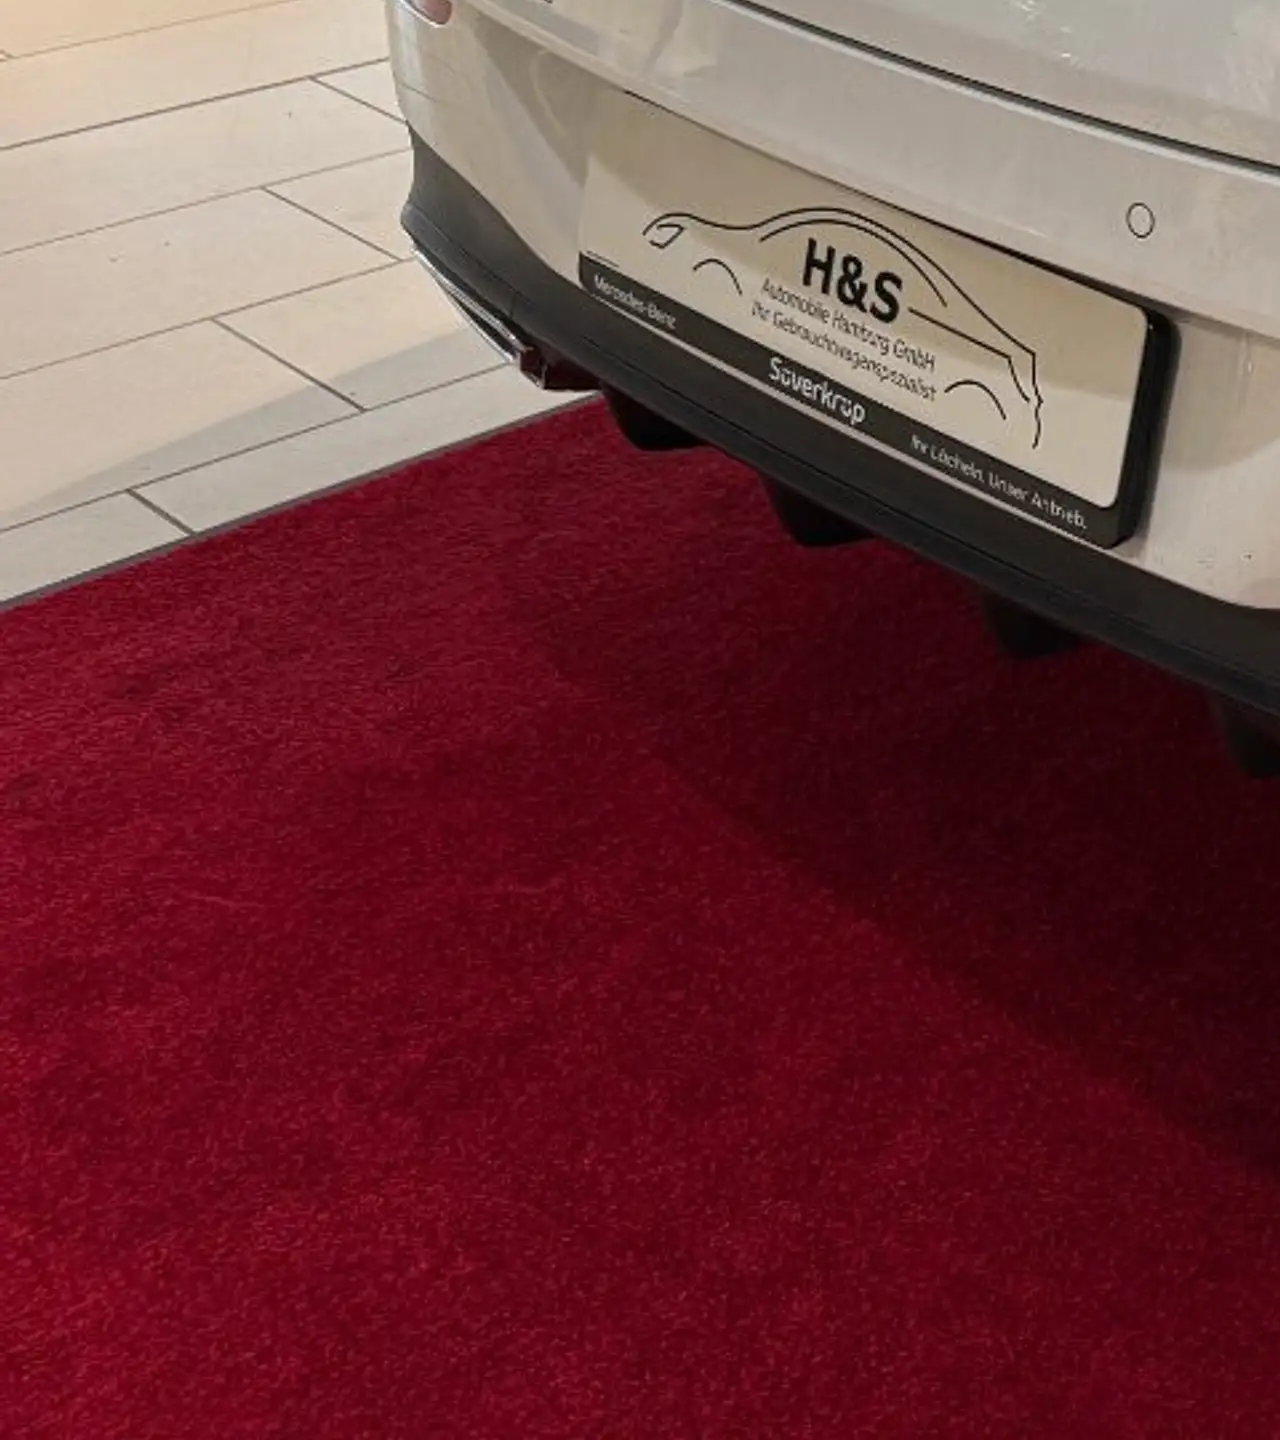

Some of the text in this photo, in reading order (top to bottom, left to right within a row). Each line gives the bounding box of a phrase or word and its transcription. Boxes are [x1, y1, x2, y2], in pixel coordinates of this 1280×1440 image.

[752, 300, 771, 322] Ihr
[803, 237, 903, 324] H&S
[762, 278, 937, 374] Automobile Hamburg GmbH
